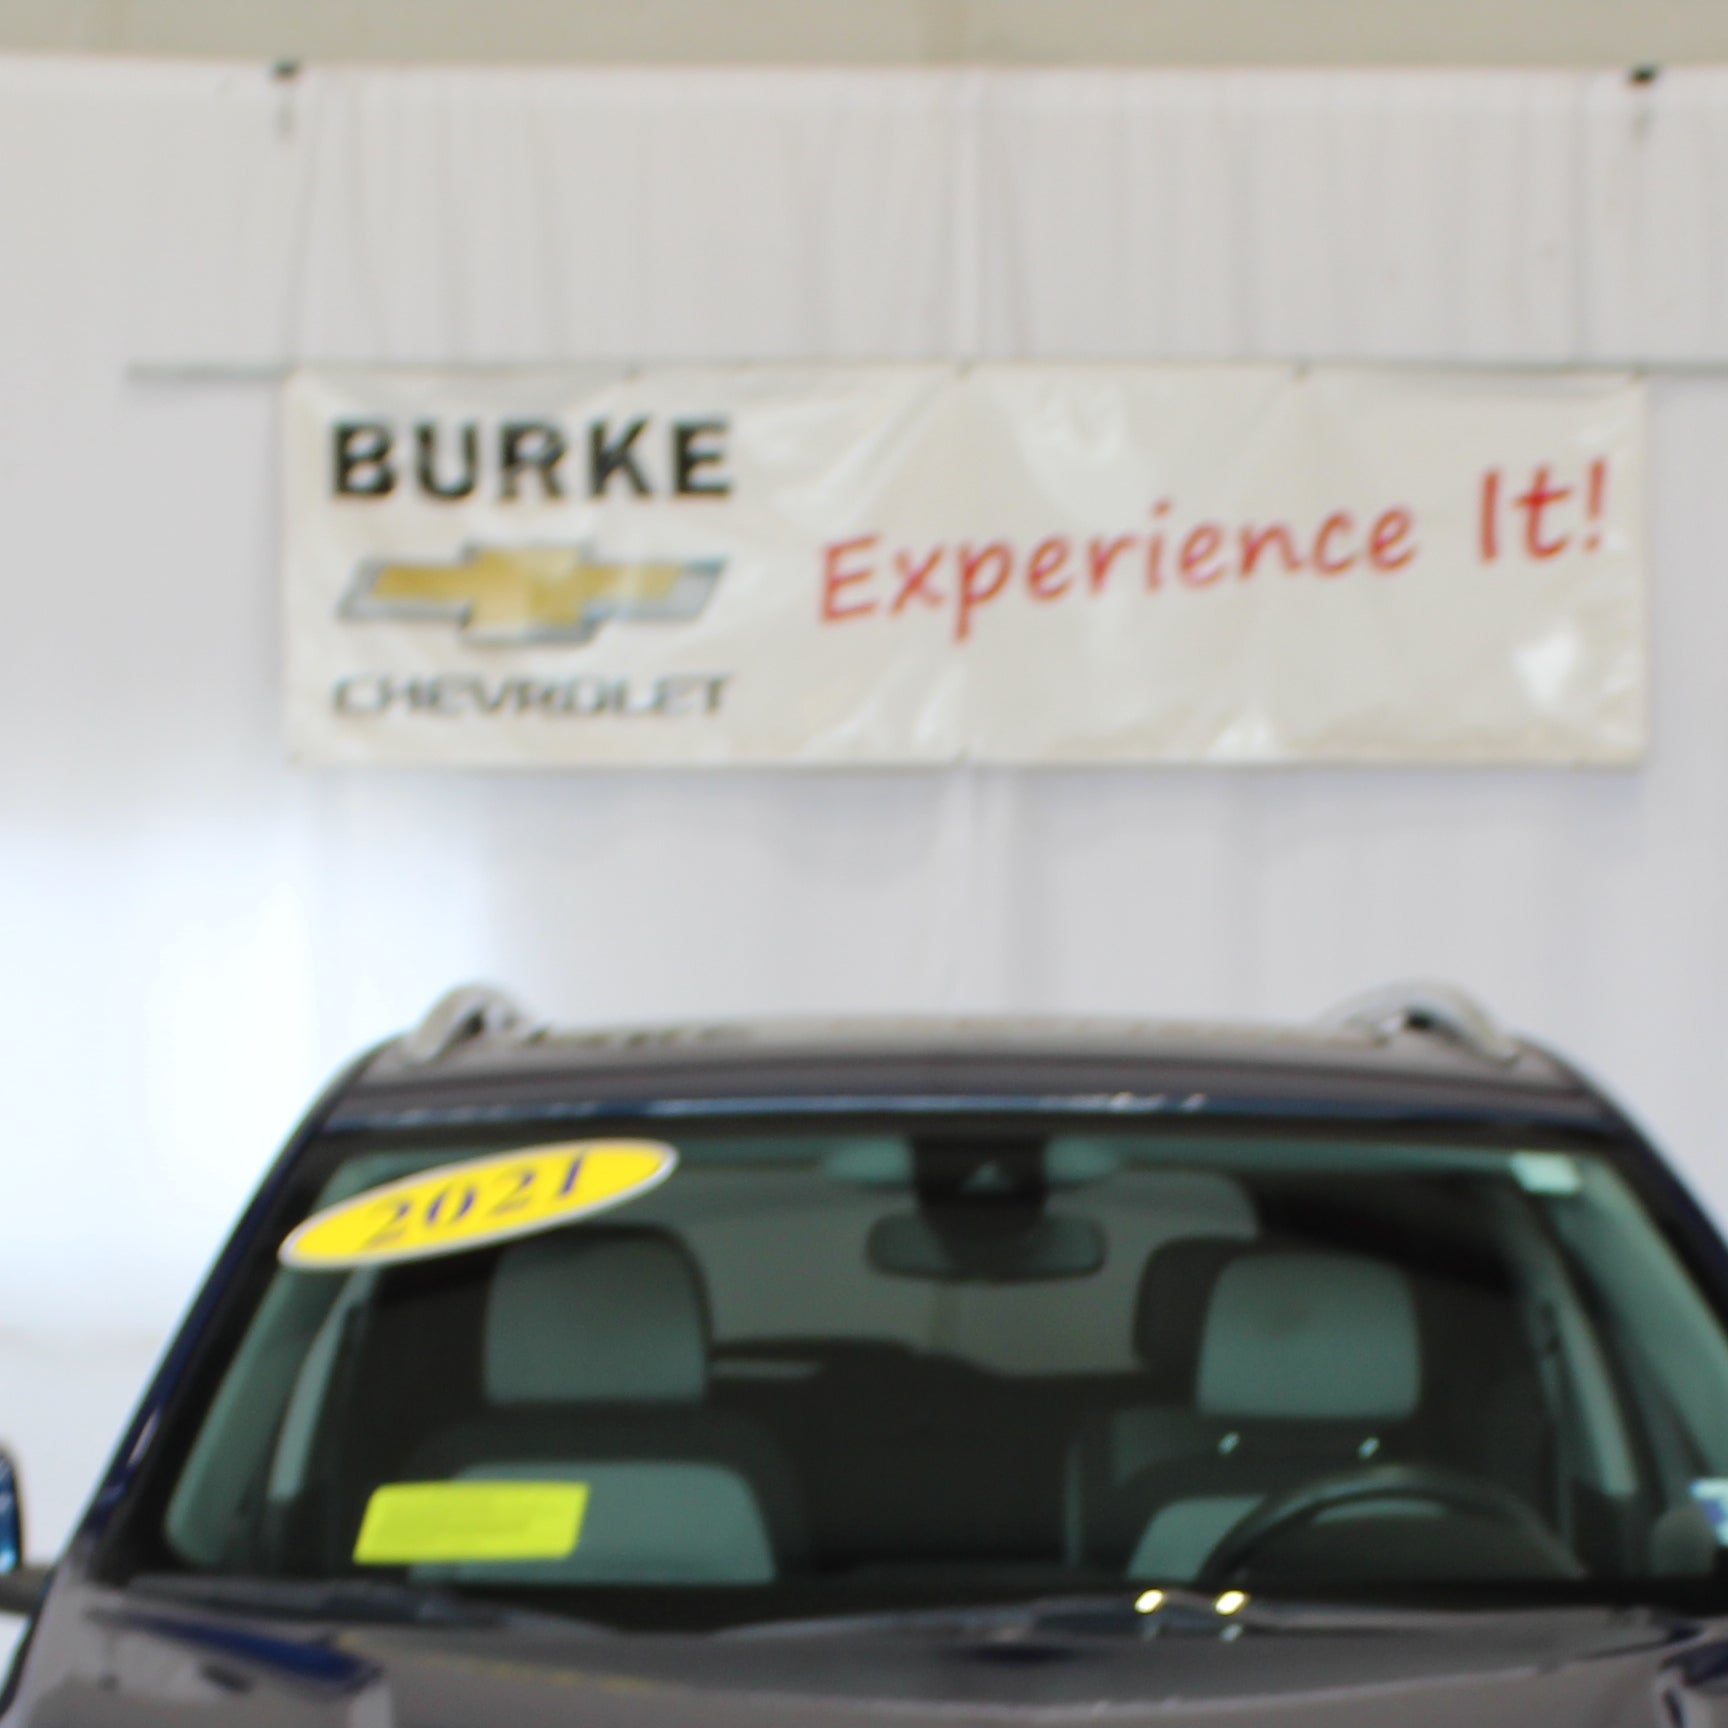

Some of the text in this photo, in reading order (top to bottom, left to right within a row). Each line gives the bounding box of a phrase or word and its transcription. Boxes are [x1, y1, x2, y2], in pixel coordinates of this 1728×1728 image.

[333, 417, 732, 500] BURKE
[820, 459, 1606, 643] Experience It!
[332, 674, 732, 716] CHEVROLET
[364, 1150, 588, 1252] 2021
